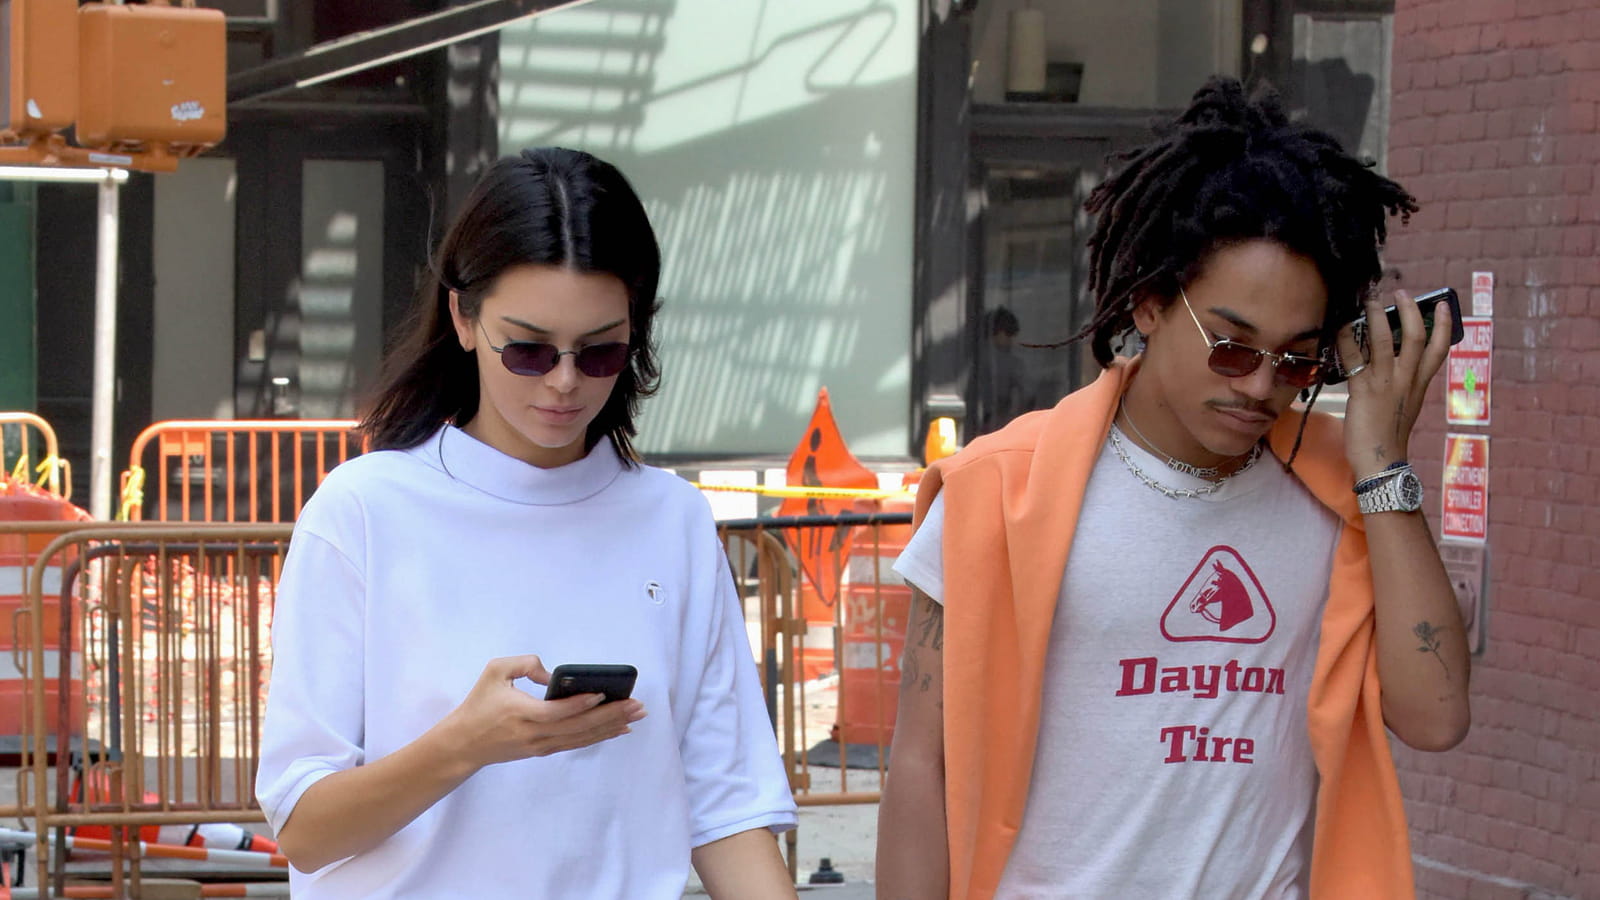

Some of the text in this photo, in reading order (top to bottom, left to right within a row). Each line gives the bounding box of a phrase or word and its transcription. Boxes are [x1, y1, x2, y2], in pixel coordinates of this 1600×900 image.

[1168, 457, 1191, 472] HOT
[1447, 489, 1482, 509] SPRINKLER
[1445, 512, 1484, 532] CONNECTION
[1115, 657, 1285, 699] Dayton
[1160, 725, 1254, 764] Tire
